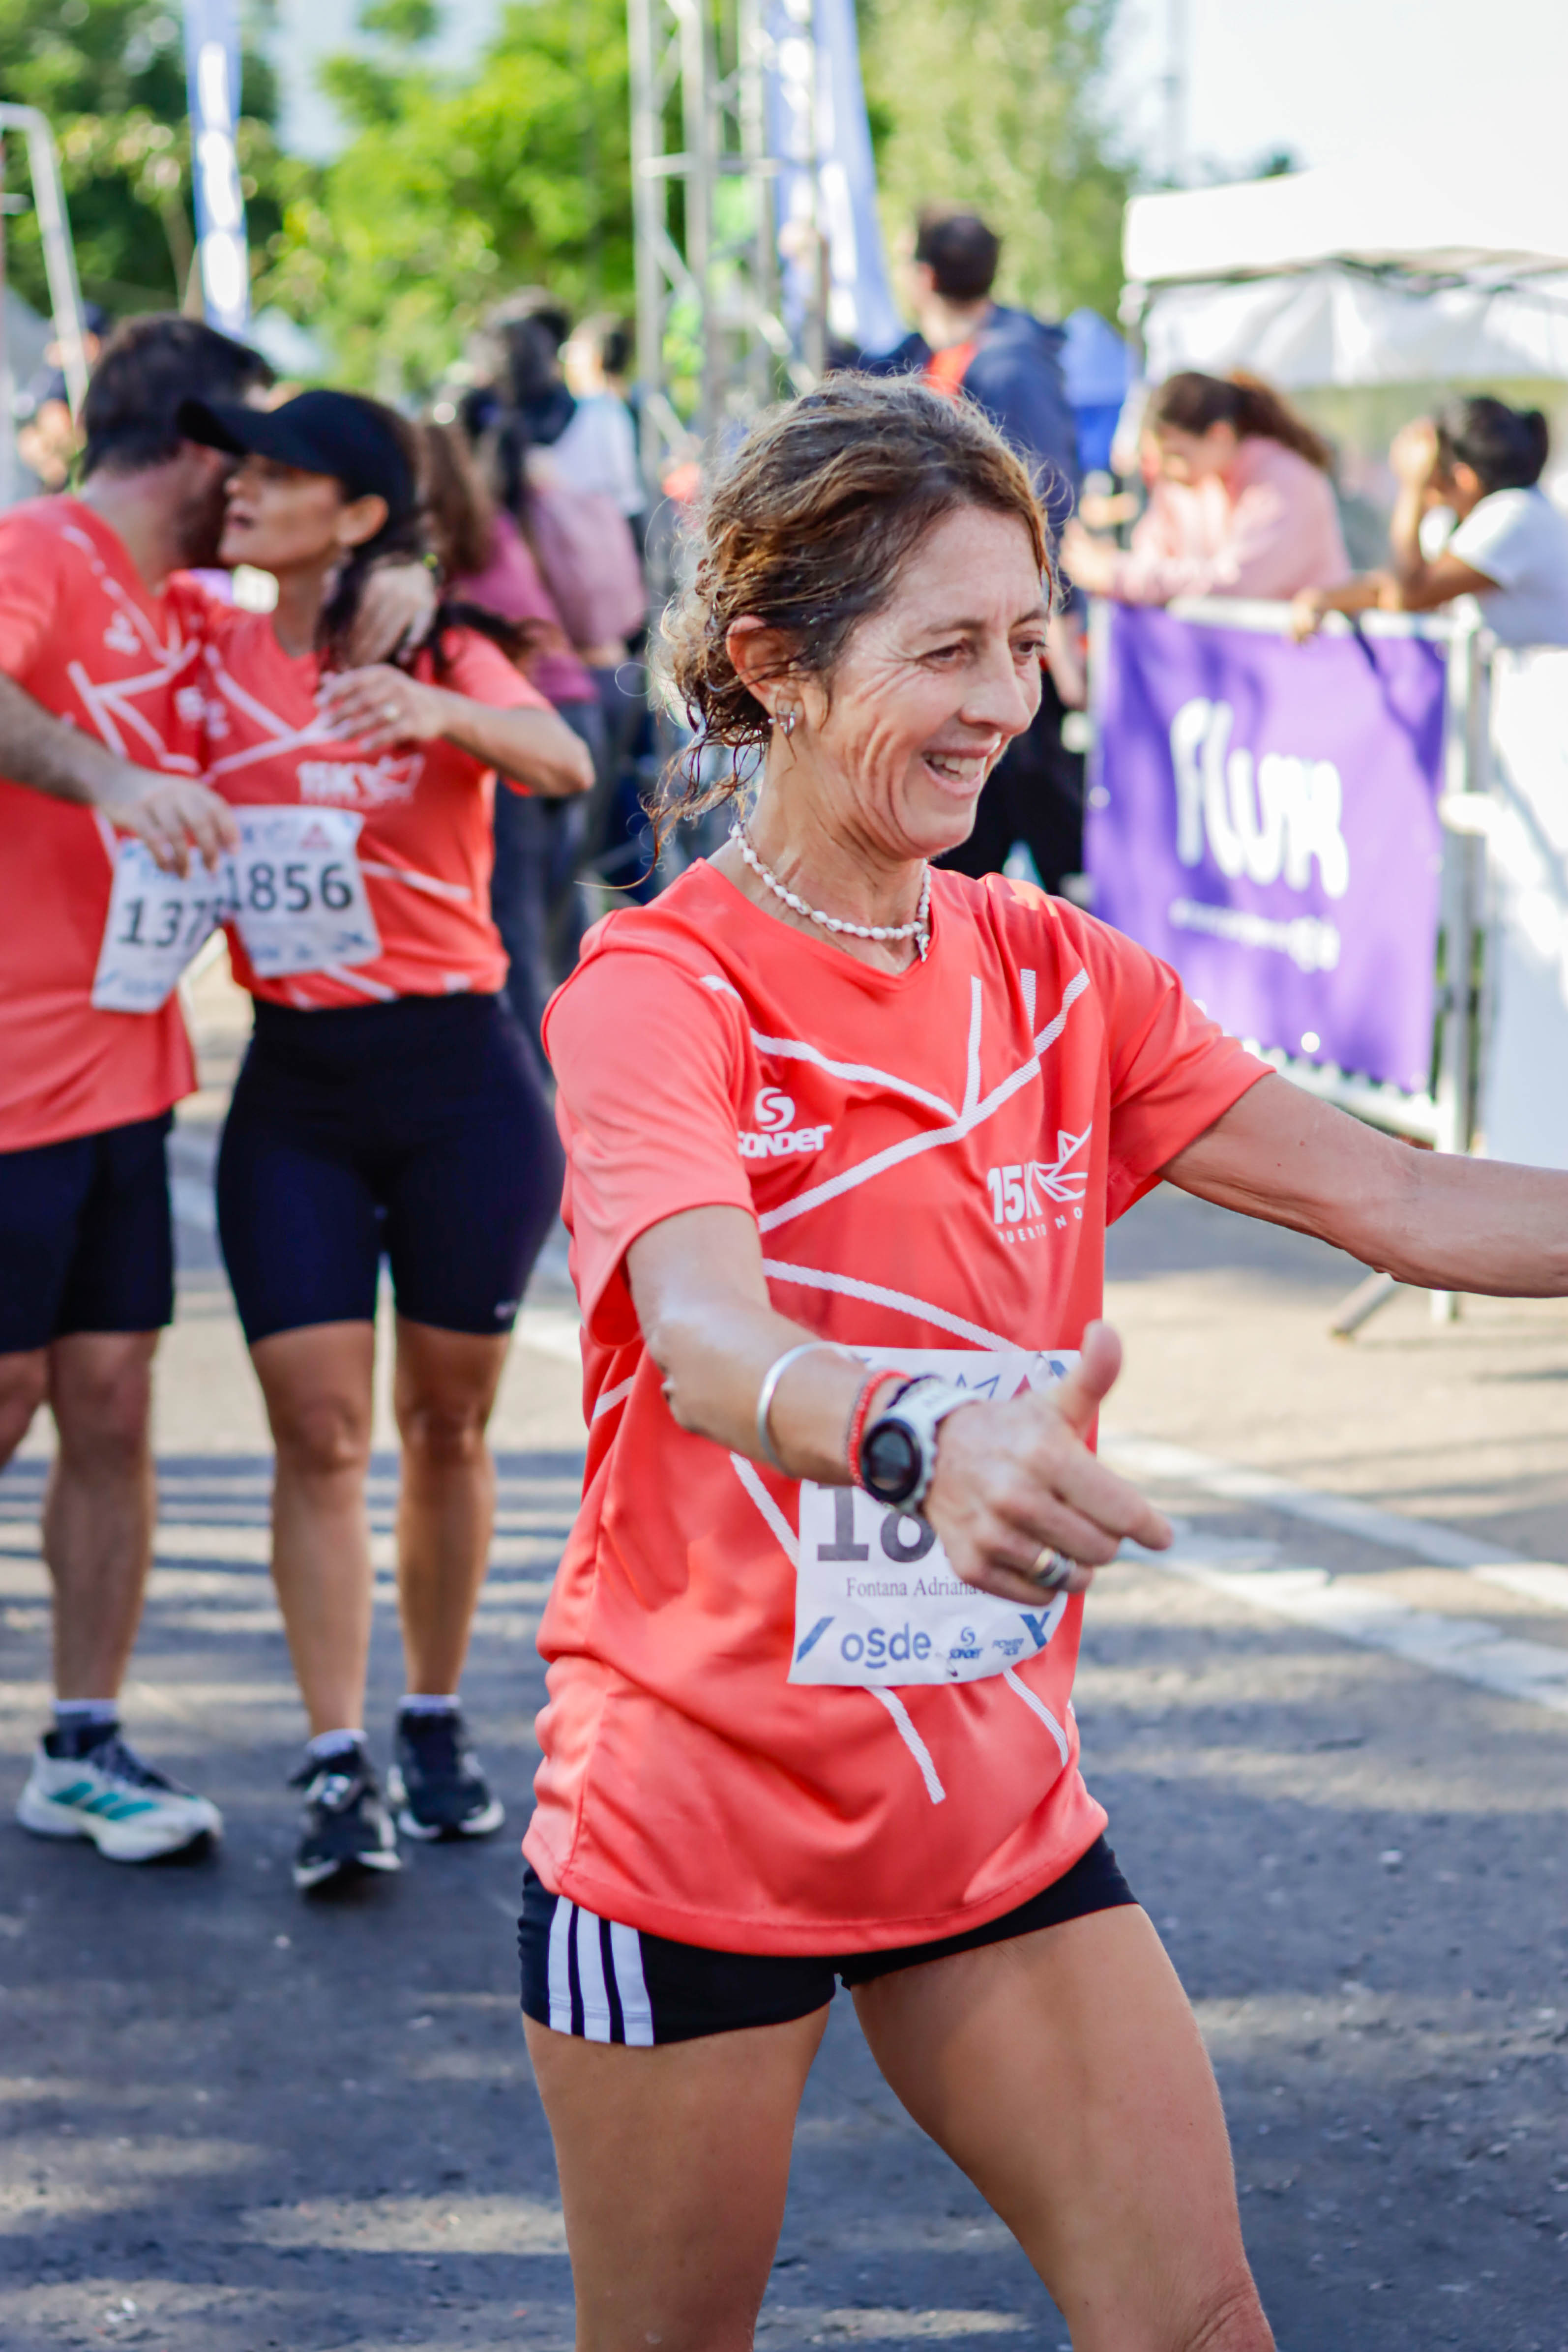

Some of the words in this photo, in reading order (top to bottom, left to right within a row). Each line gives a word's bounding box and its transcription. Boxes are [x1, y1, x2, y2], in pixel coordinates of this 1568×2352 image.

[225, 862, 353, 912] 1856
[117, 897, 224, 947] 137
[987, 1161, 1043, 1224] 15K
[846, 1577, 907, 1596] Fontana
[914, 1576, 976, 1595] Adriana
[840, 1623, 932, 1662] osde
